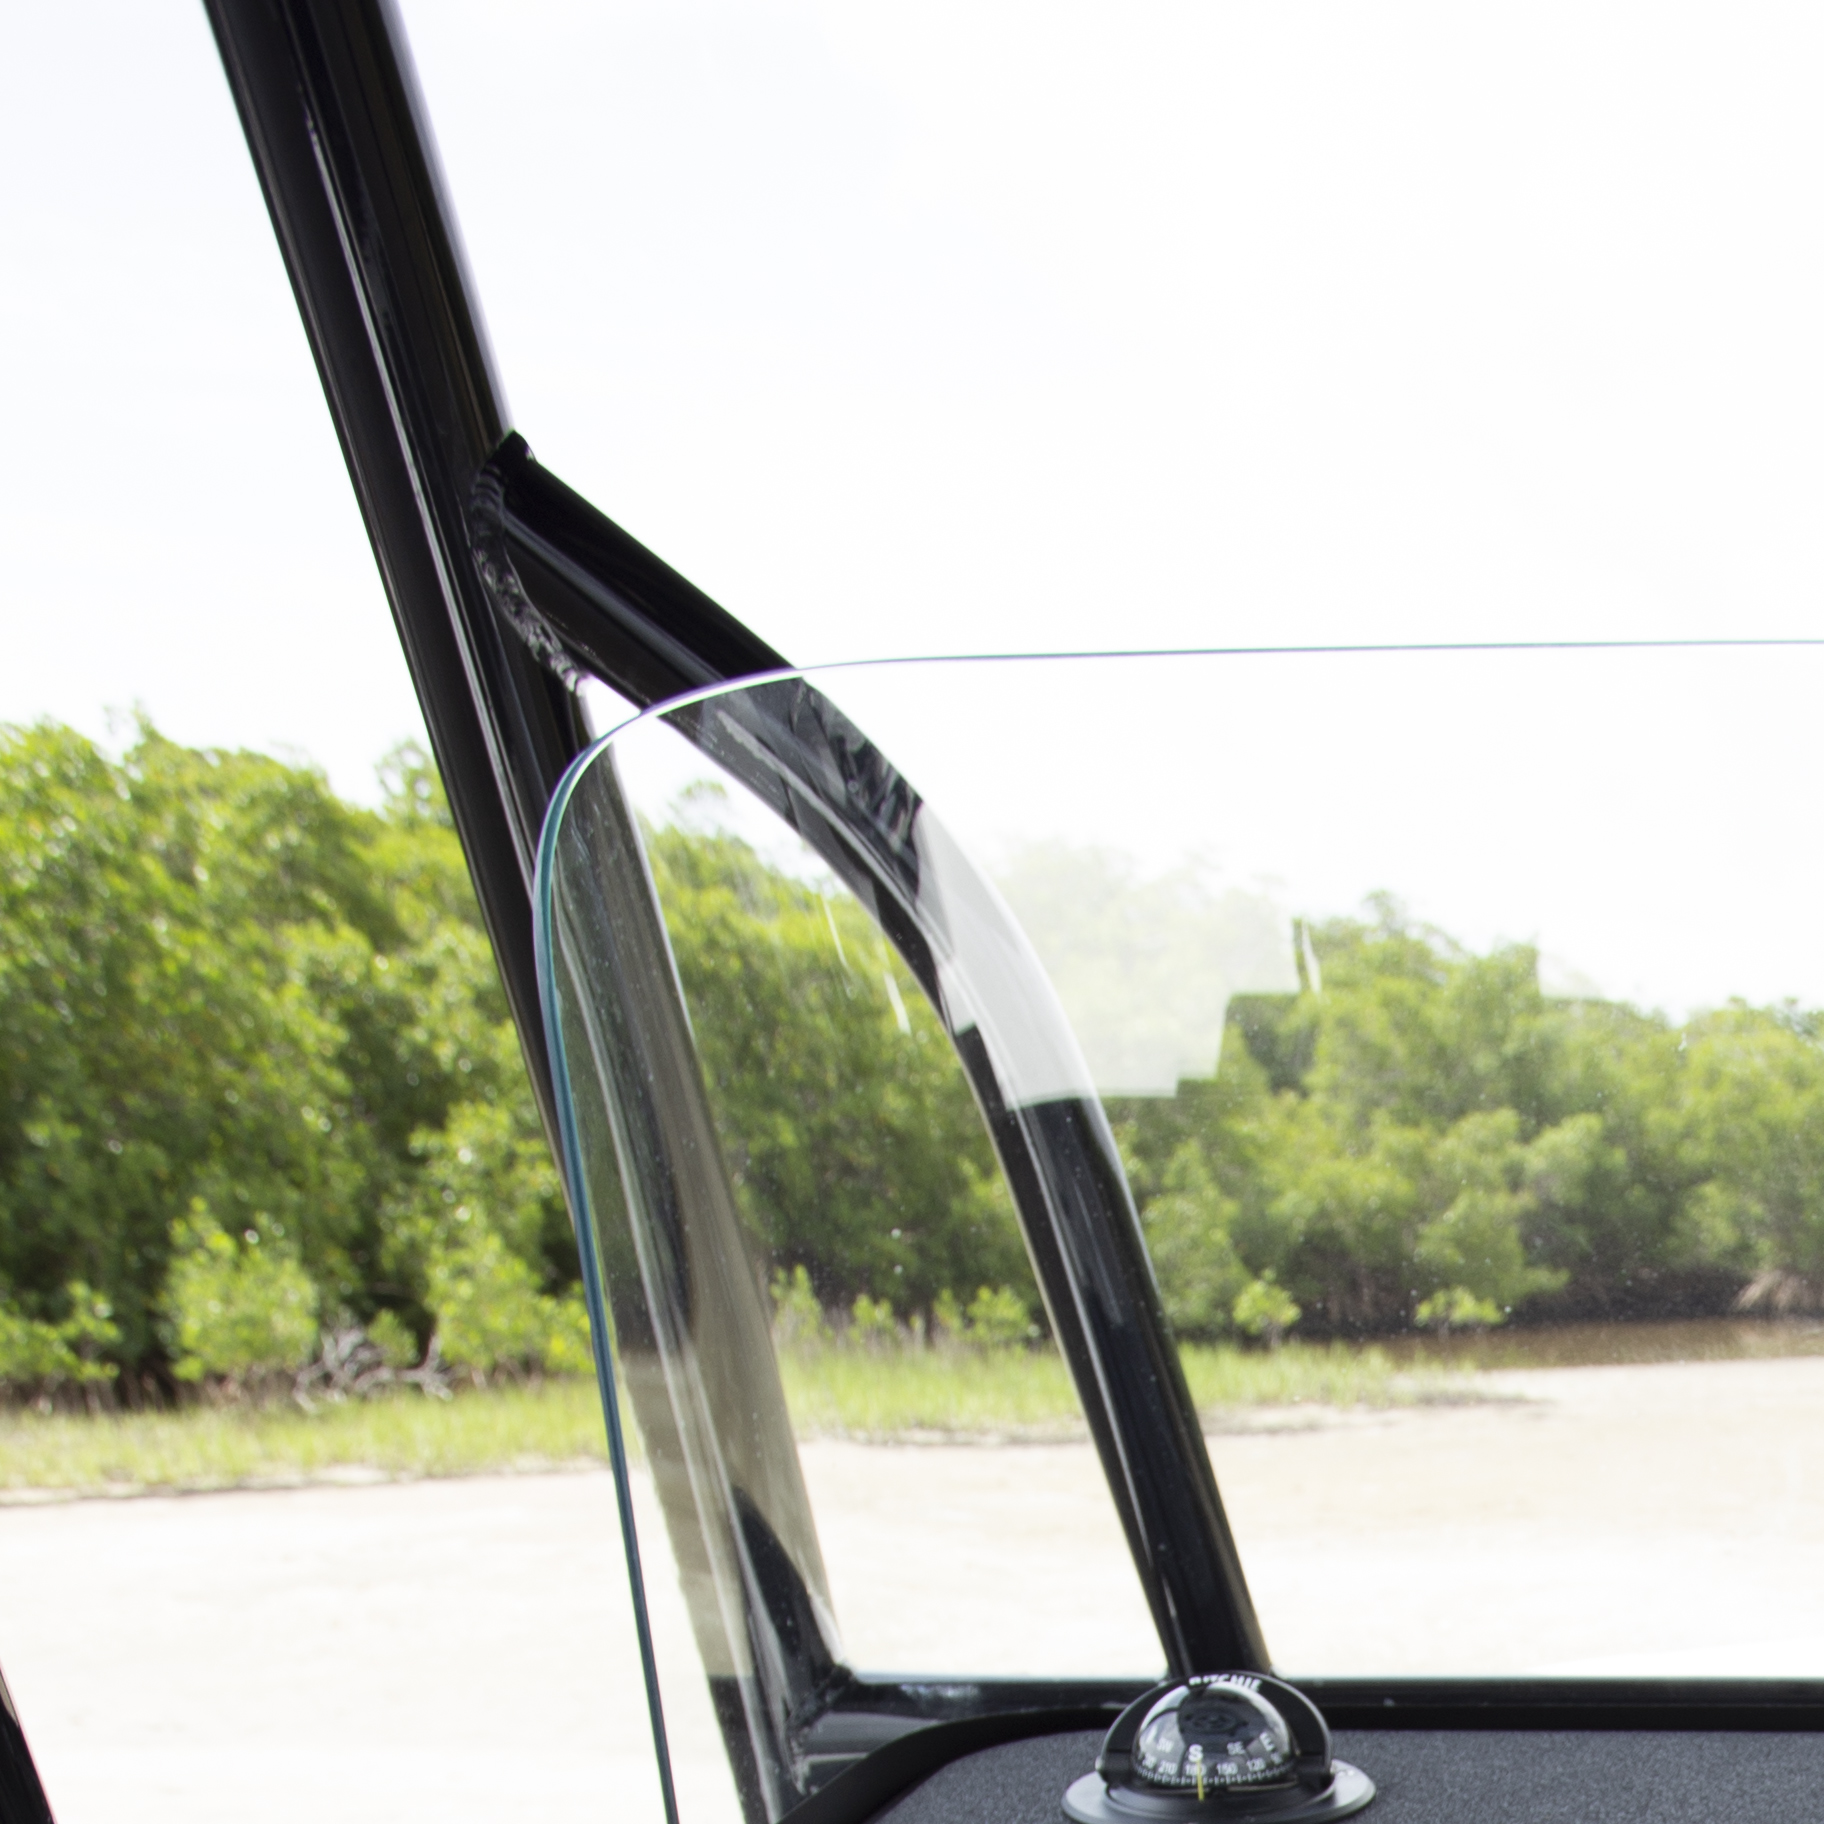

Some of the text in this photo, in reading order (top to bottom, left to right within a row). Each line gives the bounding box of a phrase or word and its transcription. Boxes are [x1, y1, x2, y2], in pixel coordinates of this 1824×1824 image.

[1189, 1674, 1262, 1692] RITCHIE
[1189, 1744, 1203, 1762] S
[1227, 1741, 1245, 1755] SE
[1260, 1732, 1274, 1751] E
[1216, 1761, 1238, 1774] 150
[1246, 1758, 1265, 1771] 120
